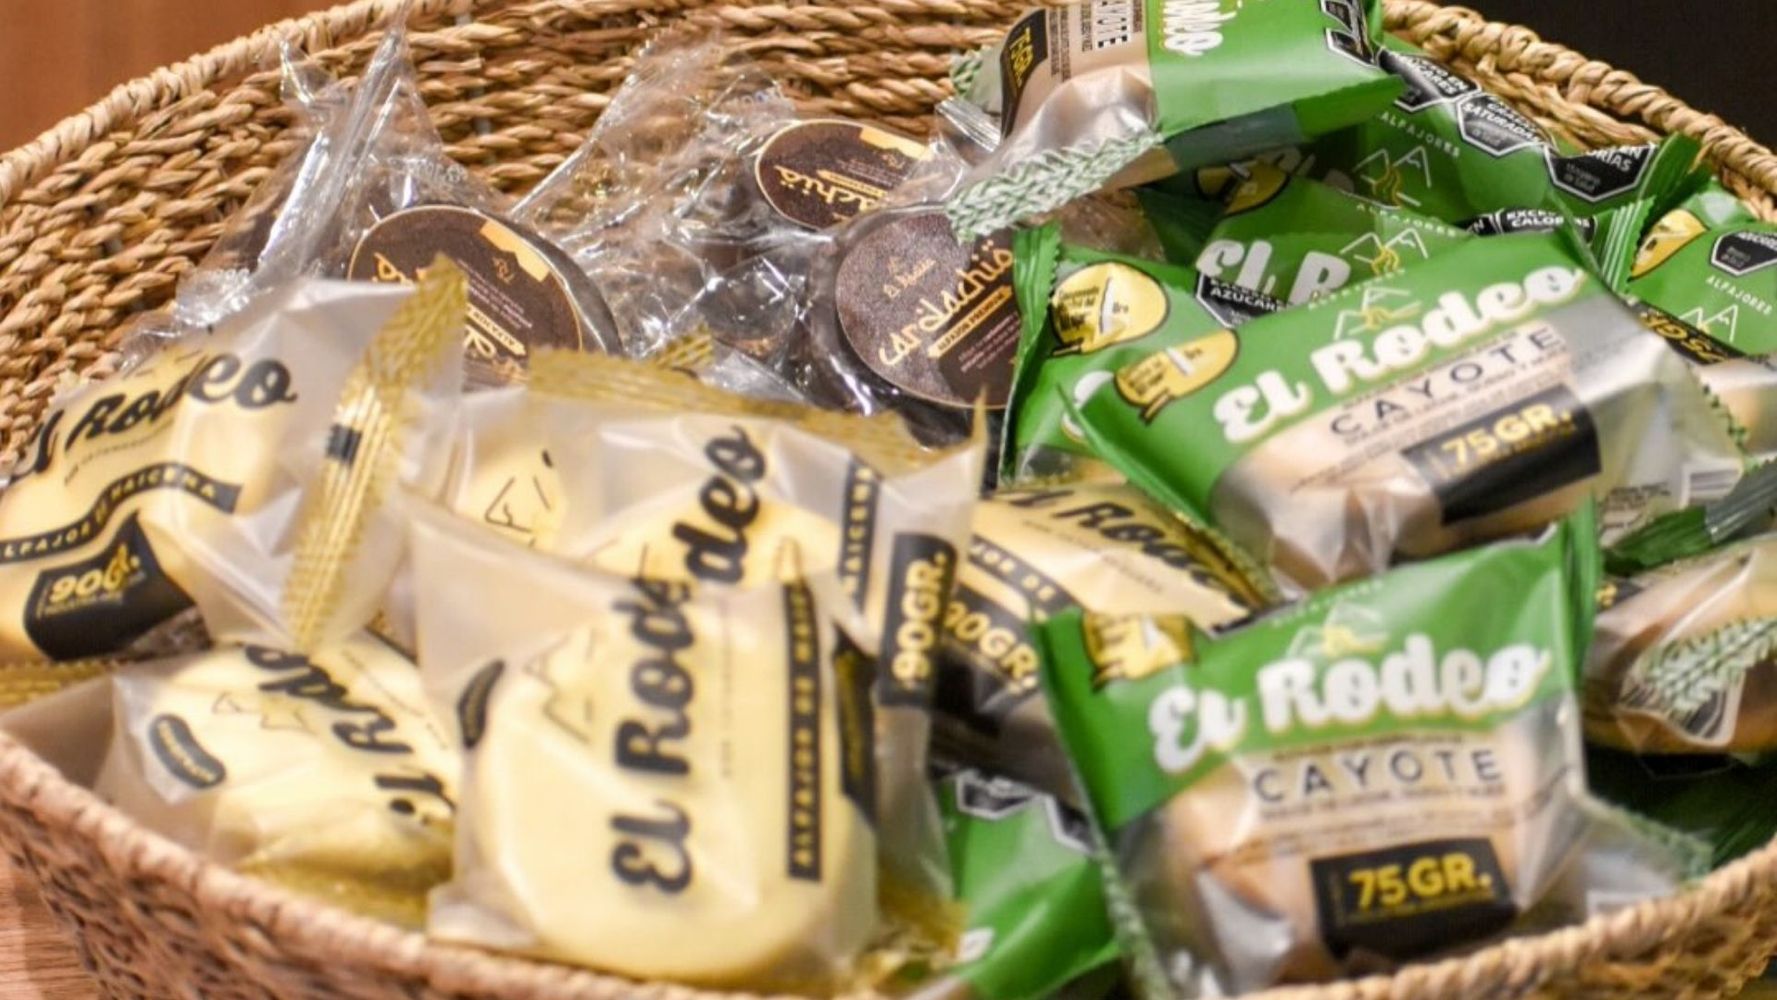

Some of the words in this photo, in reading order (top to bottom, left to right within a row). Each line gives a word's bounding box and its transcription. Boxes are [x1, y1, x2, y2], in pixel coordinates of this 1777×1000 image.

[1380, 111, 1461, 158] ALFAJORES
[1706, 275, 1774, 316] ALFAJORES
[64, 351, 299, 451] Rodeo
[1212, 370, 1312, 444] El
[1308, 265, 1588, 396] Rodeo
[1330, 327, 1561, 437] CAYOTE
[1440, 402, 1573, 468] 75GR.
[2, 520, 92, 558] LFAJOR
[671, 424, 766, 585] deo
[891, 551, 948, 682] 90GR.
[1255, 632, 1551, 735] Rodeo
[1252, 746, 1503, 805] CAYOTE
[609, 799, 693, 895] El
[1347, 850, 1495, 911] 75GR.
